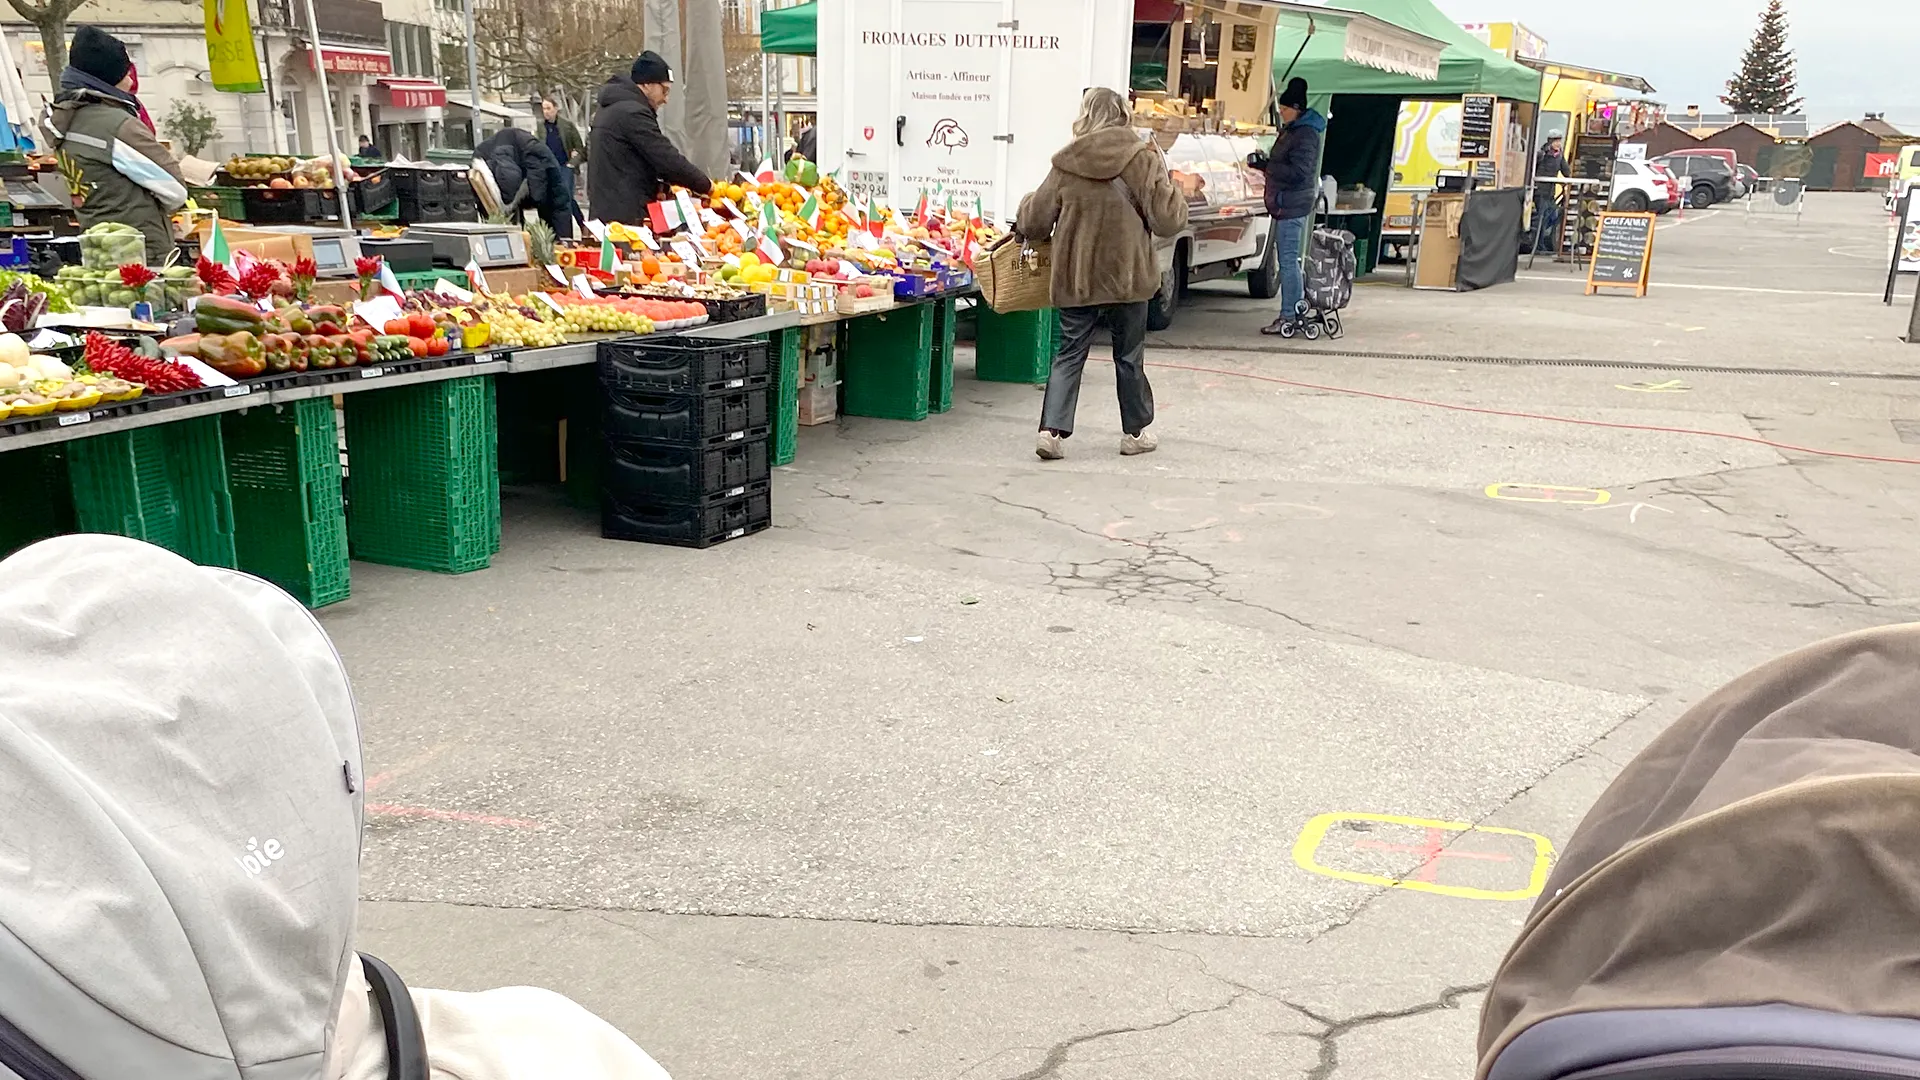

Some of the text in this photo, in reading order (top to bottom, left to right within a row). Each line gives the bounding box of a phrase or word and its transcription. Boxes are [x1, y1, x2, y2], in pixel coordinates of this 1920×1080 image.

[862, 31, 1060, 49] FROMAGES DUTTWEILER
[906, 70, 942, 81] Artisan
[950, 71, 991, 82] Affineur
[911, 92, 938, 100] Maison
[974, 93, 991, 102] 1978
[863, 172, 874, 182] VD
[902, 175, 924, 183] 1072
[952, 177, 993, 187] (Lavaux)
